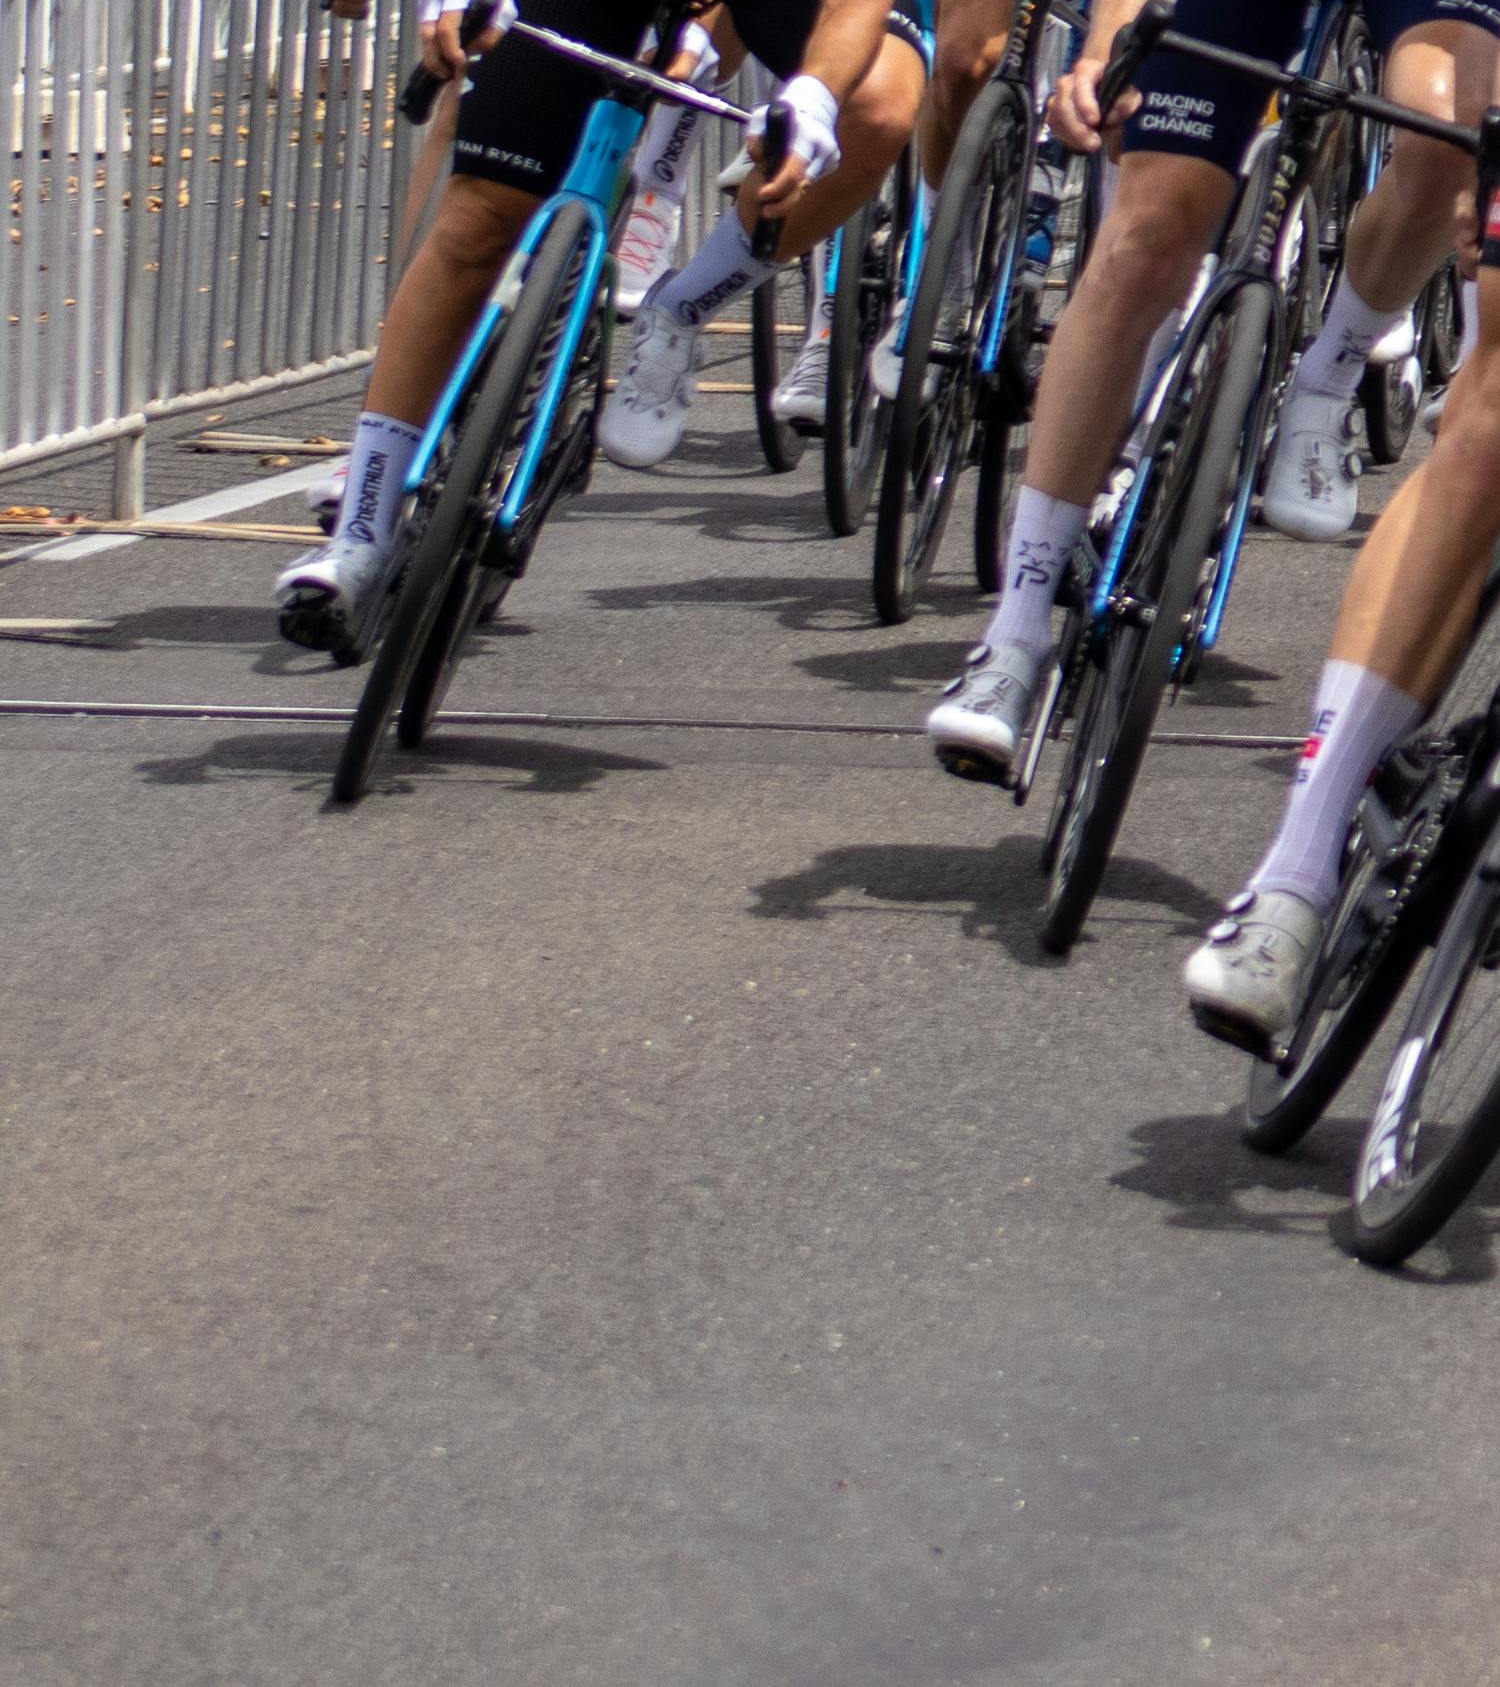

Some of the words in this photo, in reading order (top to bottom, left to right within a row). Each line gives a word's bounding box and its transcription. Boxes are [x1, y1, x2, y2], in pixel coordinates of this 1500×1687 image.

[1148, 92, 1216, 116] RACING
[665, 106, 698, 164] DECATHLO
[1139, 113, 1216, 141] CHANGE
[456, 140, 483, 155] VAN
[487, 146, 545, 173] RYSEL
[1253, 154, 1299, 265] FACTOR
[697, 268, 752, 313] DECATHLON
[360, 449, 389, 523] DECATHLON
